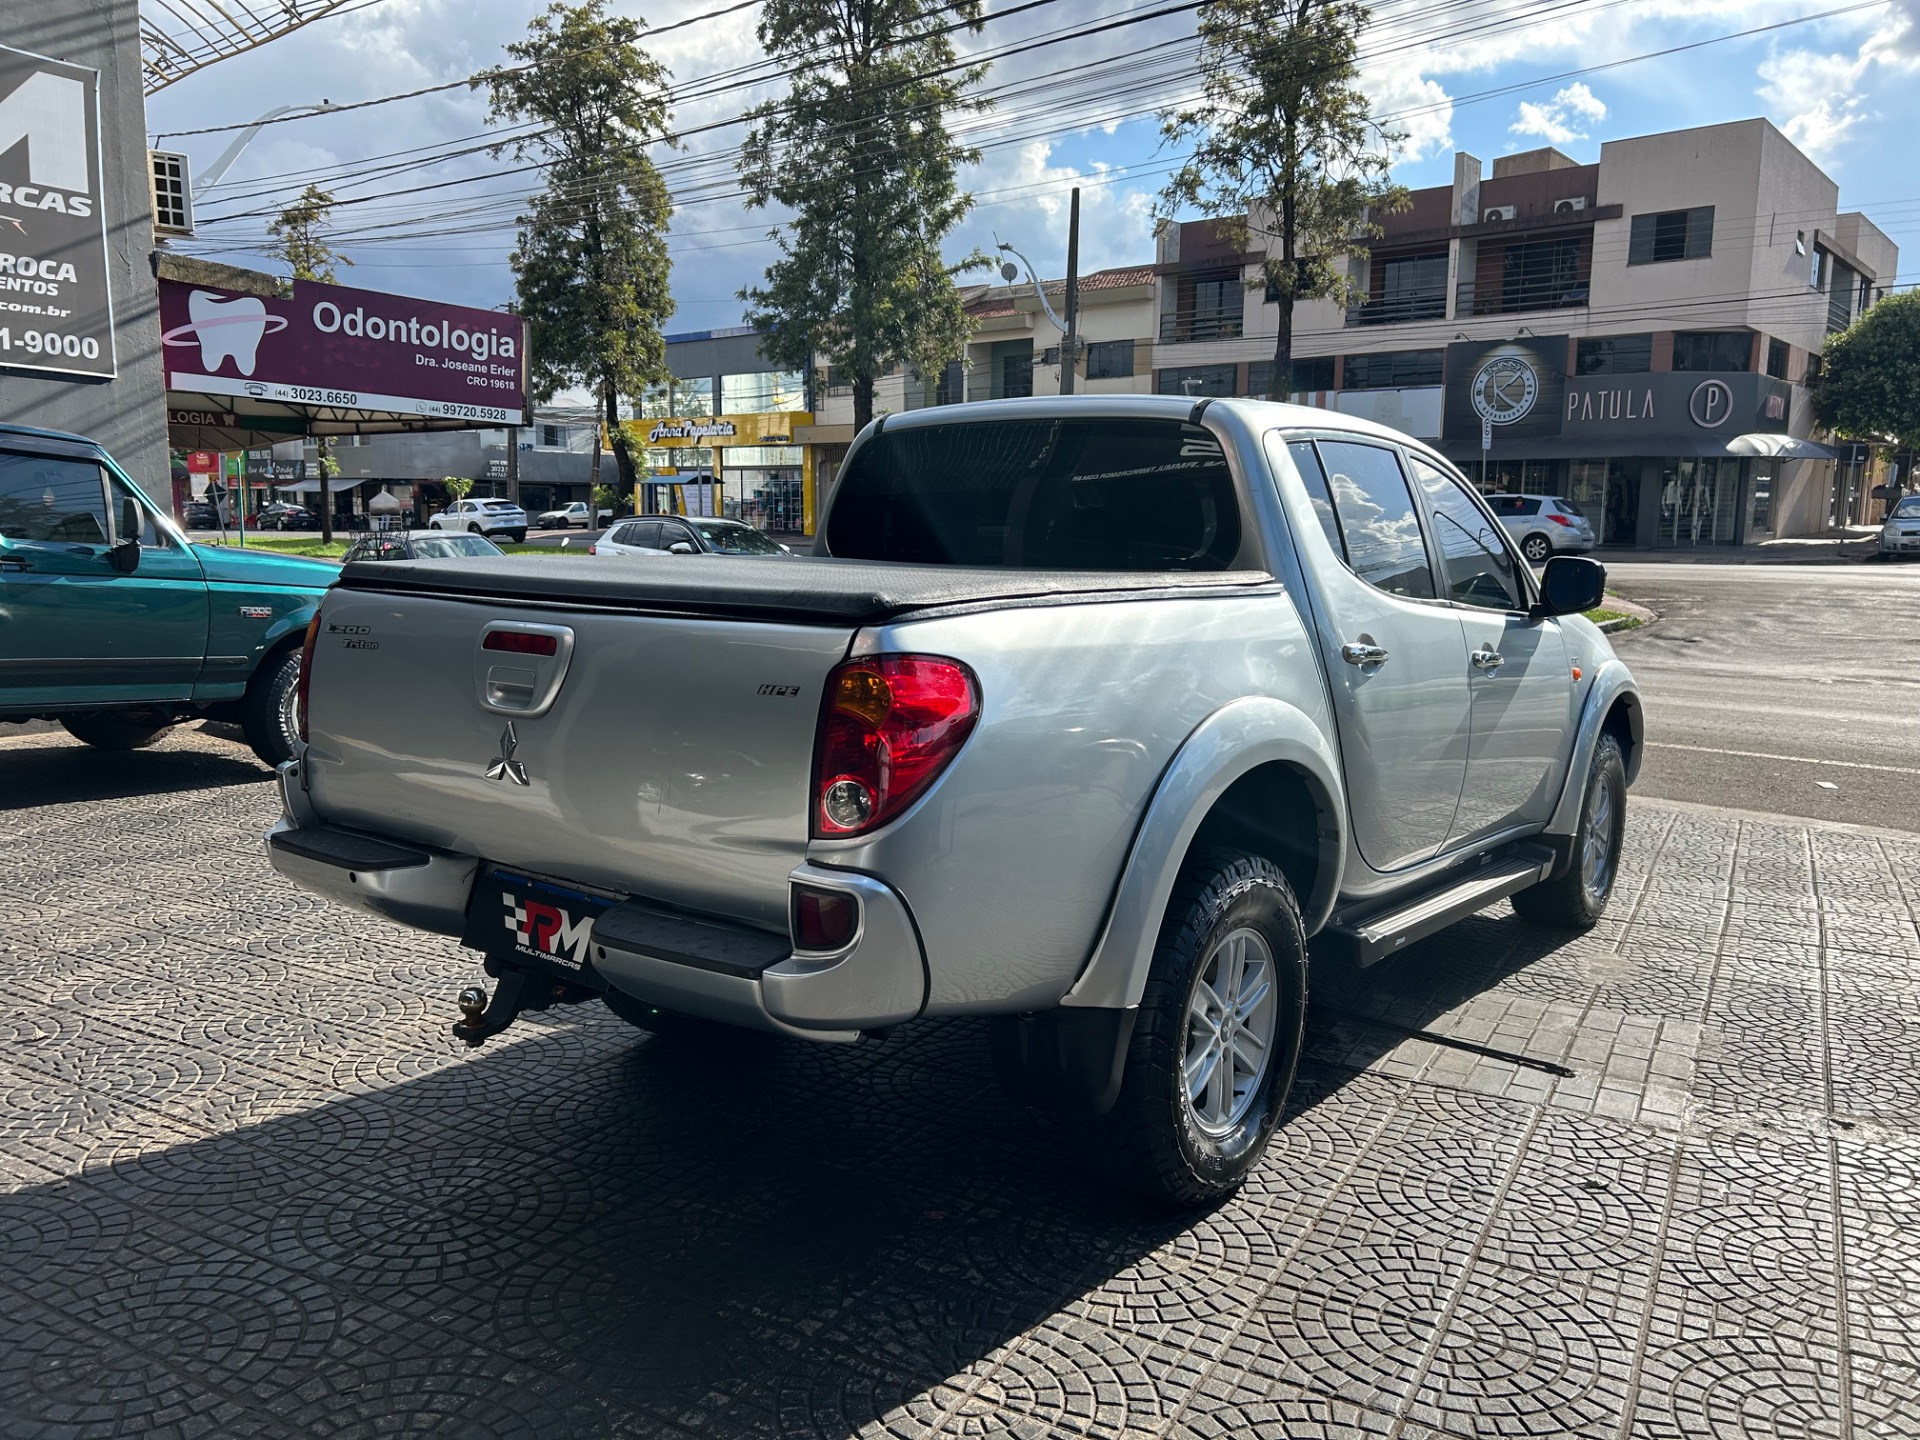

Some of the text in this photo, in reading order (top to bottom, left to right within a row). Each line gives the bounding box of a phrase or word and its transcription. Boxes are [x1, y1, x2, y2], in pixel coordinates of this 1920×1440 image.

[313, 301, 515, 361] Odontologia
[415, 354, 516, 377] Dra. Joseane Erler
[466, 376, 515, 390] CRO 19618
[274, 387, 357, 406] (44) 3023.6650
[1567, 389, 1654, 421] PATULA
[1706, 387, 1719, 420] P
[428, 404, 507, 421] (44) 99720.5928
[650, 418, 735, 444] Anna Papelaria
[325, 624, 371, 634] L200
[343, 639, 379, 649] Triton
[757, 684, 800, 697] HPE
[515, 944, 582, 971] MULTIMARCAS
